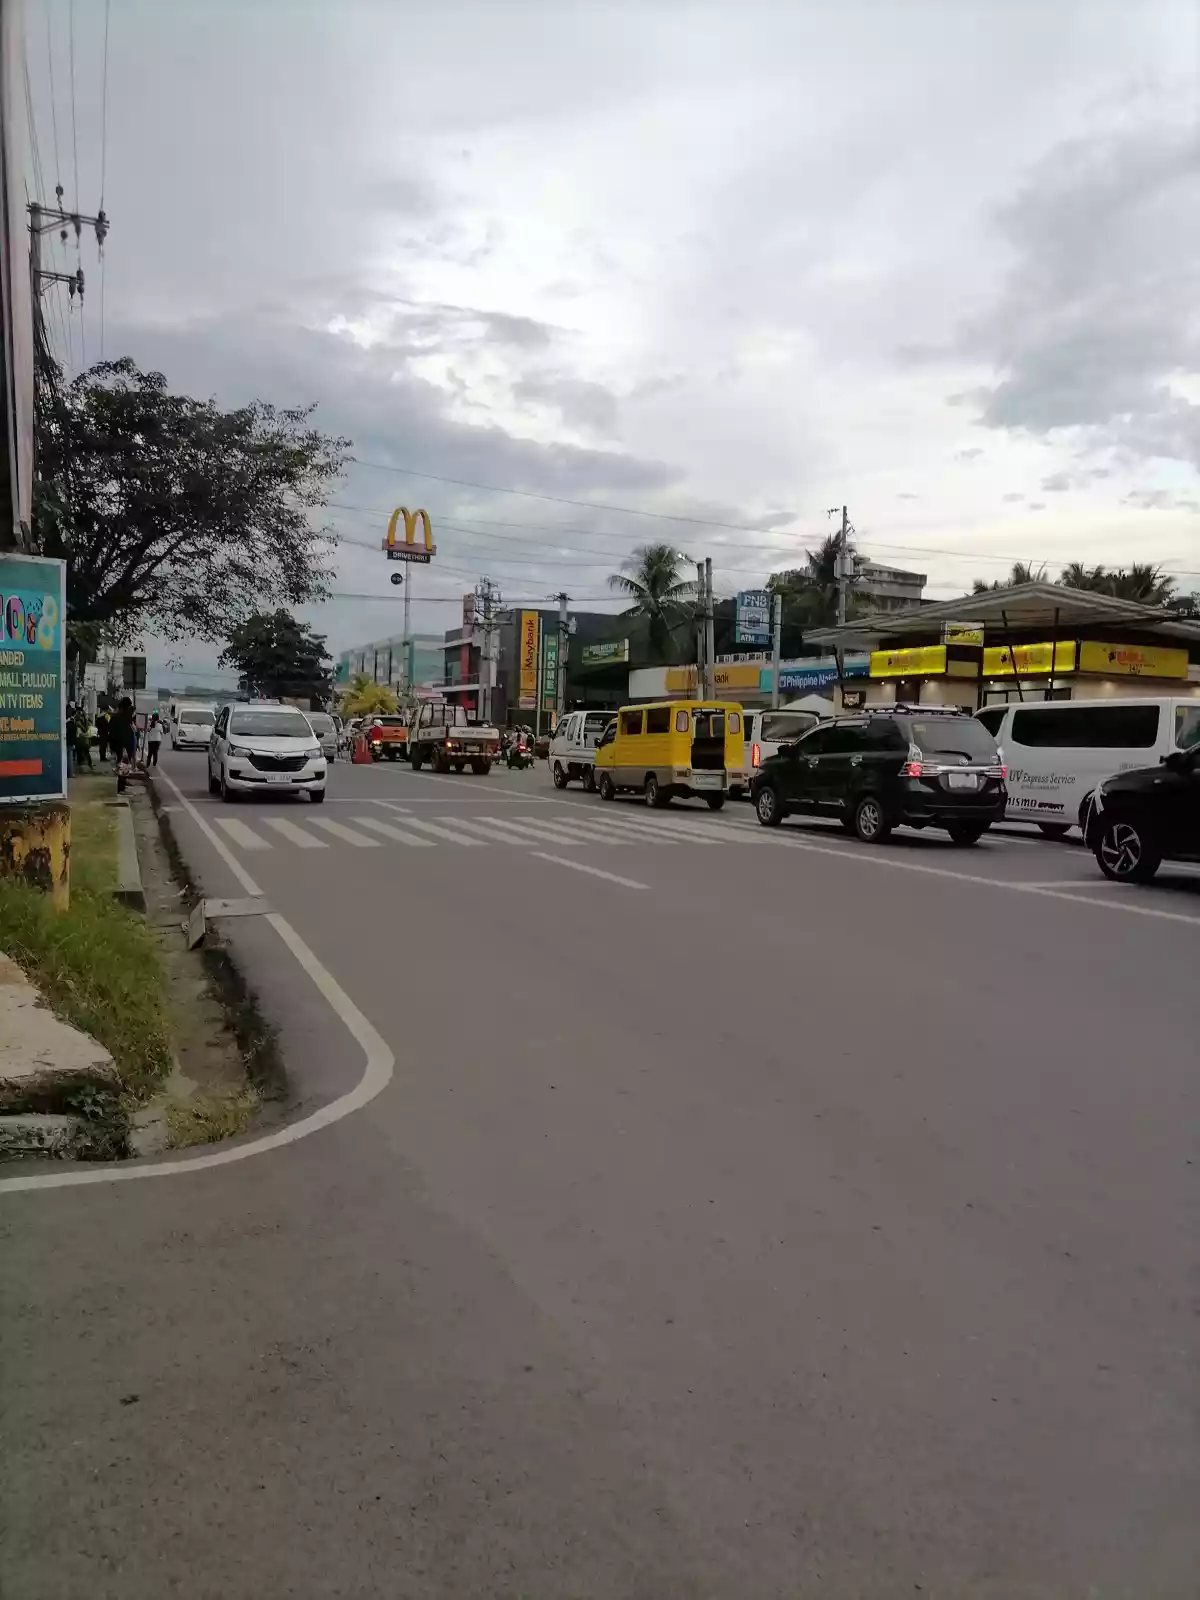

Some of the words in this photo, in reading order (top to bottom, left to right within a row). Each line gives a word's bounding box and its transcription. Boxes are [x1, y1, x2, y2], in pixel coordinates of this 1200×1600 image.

[744, 594, 767, 607] PNB
[525, 619, 535, 668] Maybank
[740, 634, 755, 642] ATM
[22, 672, 57, 689] PULLOUT
[786, 674, 818, 689] Philippine
[7, 693, 17, 709] TV
[19, 694, 44, 709] ITEMS
[1009, 769, 1023, 782] UV
[1023, 772, 1048, 784] Express
[1049, 771, 1076, 784] Service
[1038, 802, 1065, 811] SPORT
